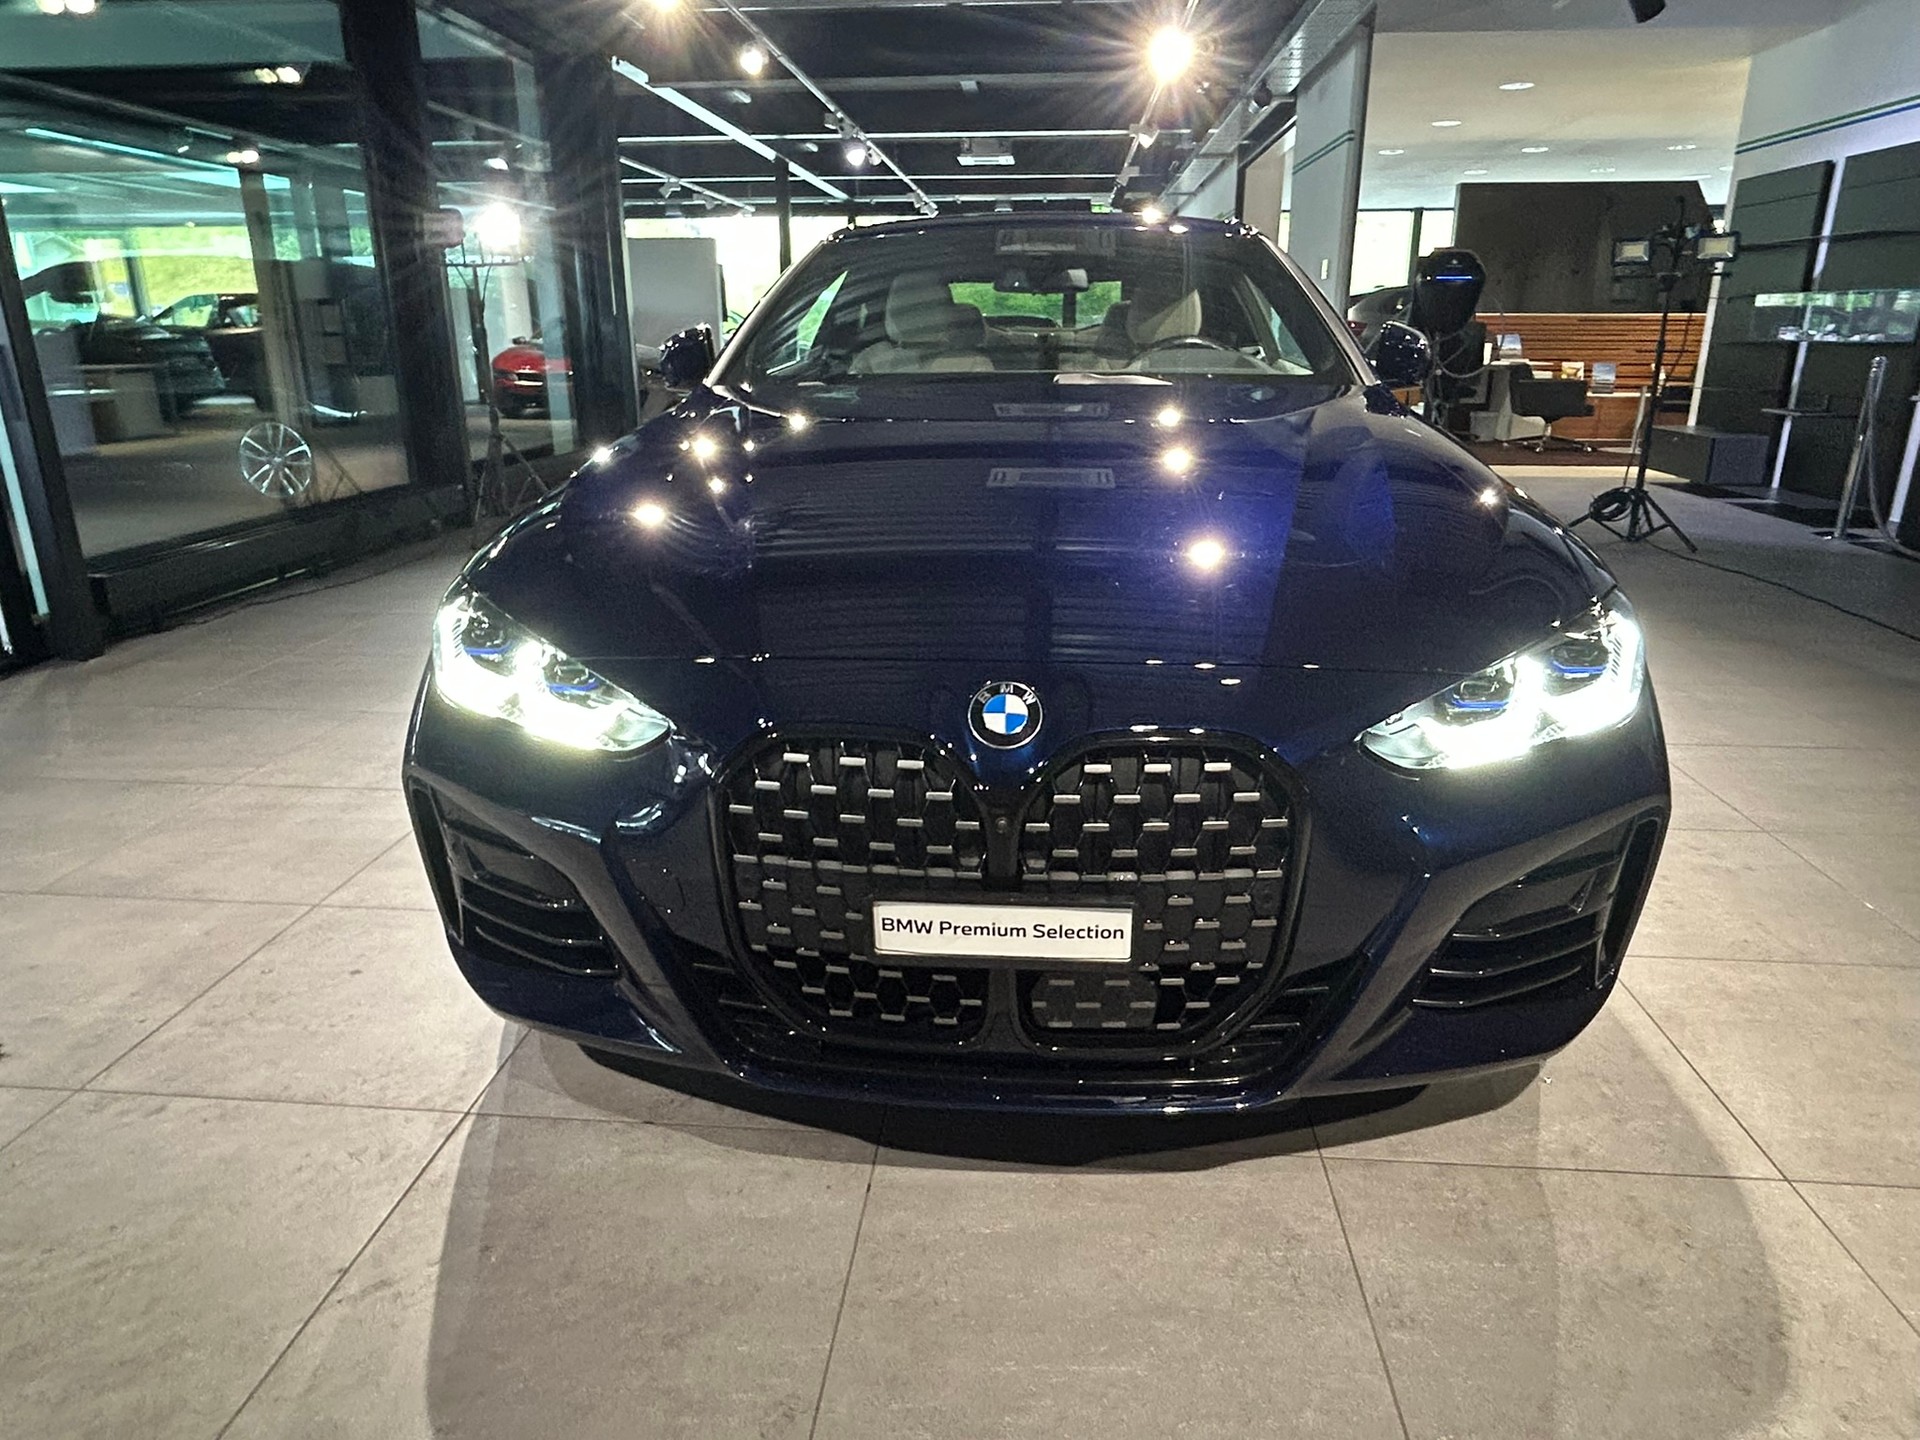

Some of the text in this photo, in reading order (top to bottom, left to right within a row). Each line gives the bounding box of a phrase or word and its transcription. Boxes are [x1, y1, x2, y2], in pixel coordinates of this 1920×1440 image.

[977, 684, 1037, 705] BMW
[881, 917, 1124, 940] BMW Premium Selection
